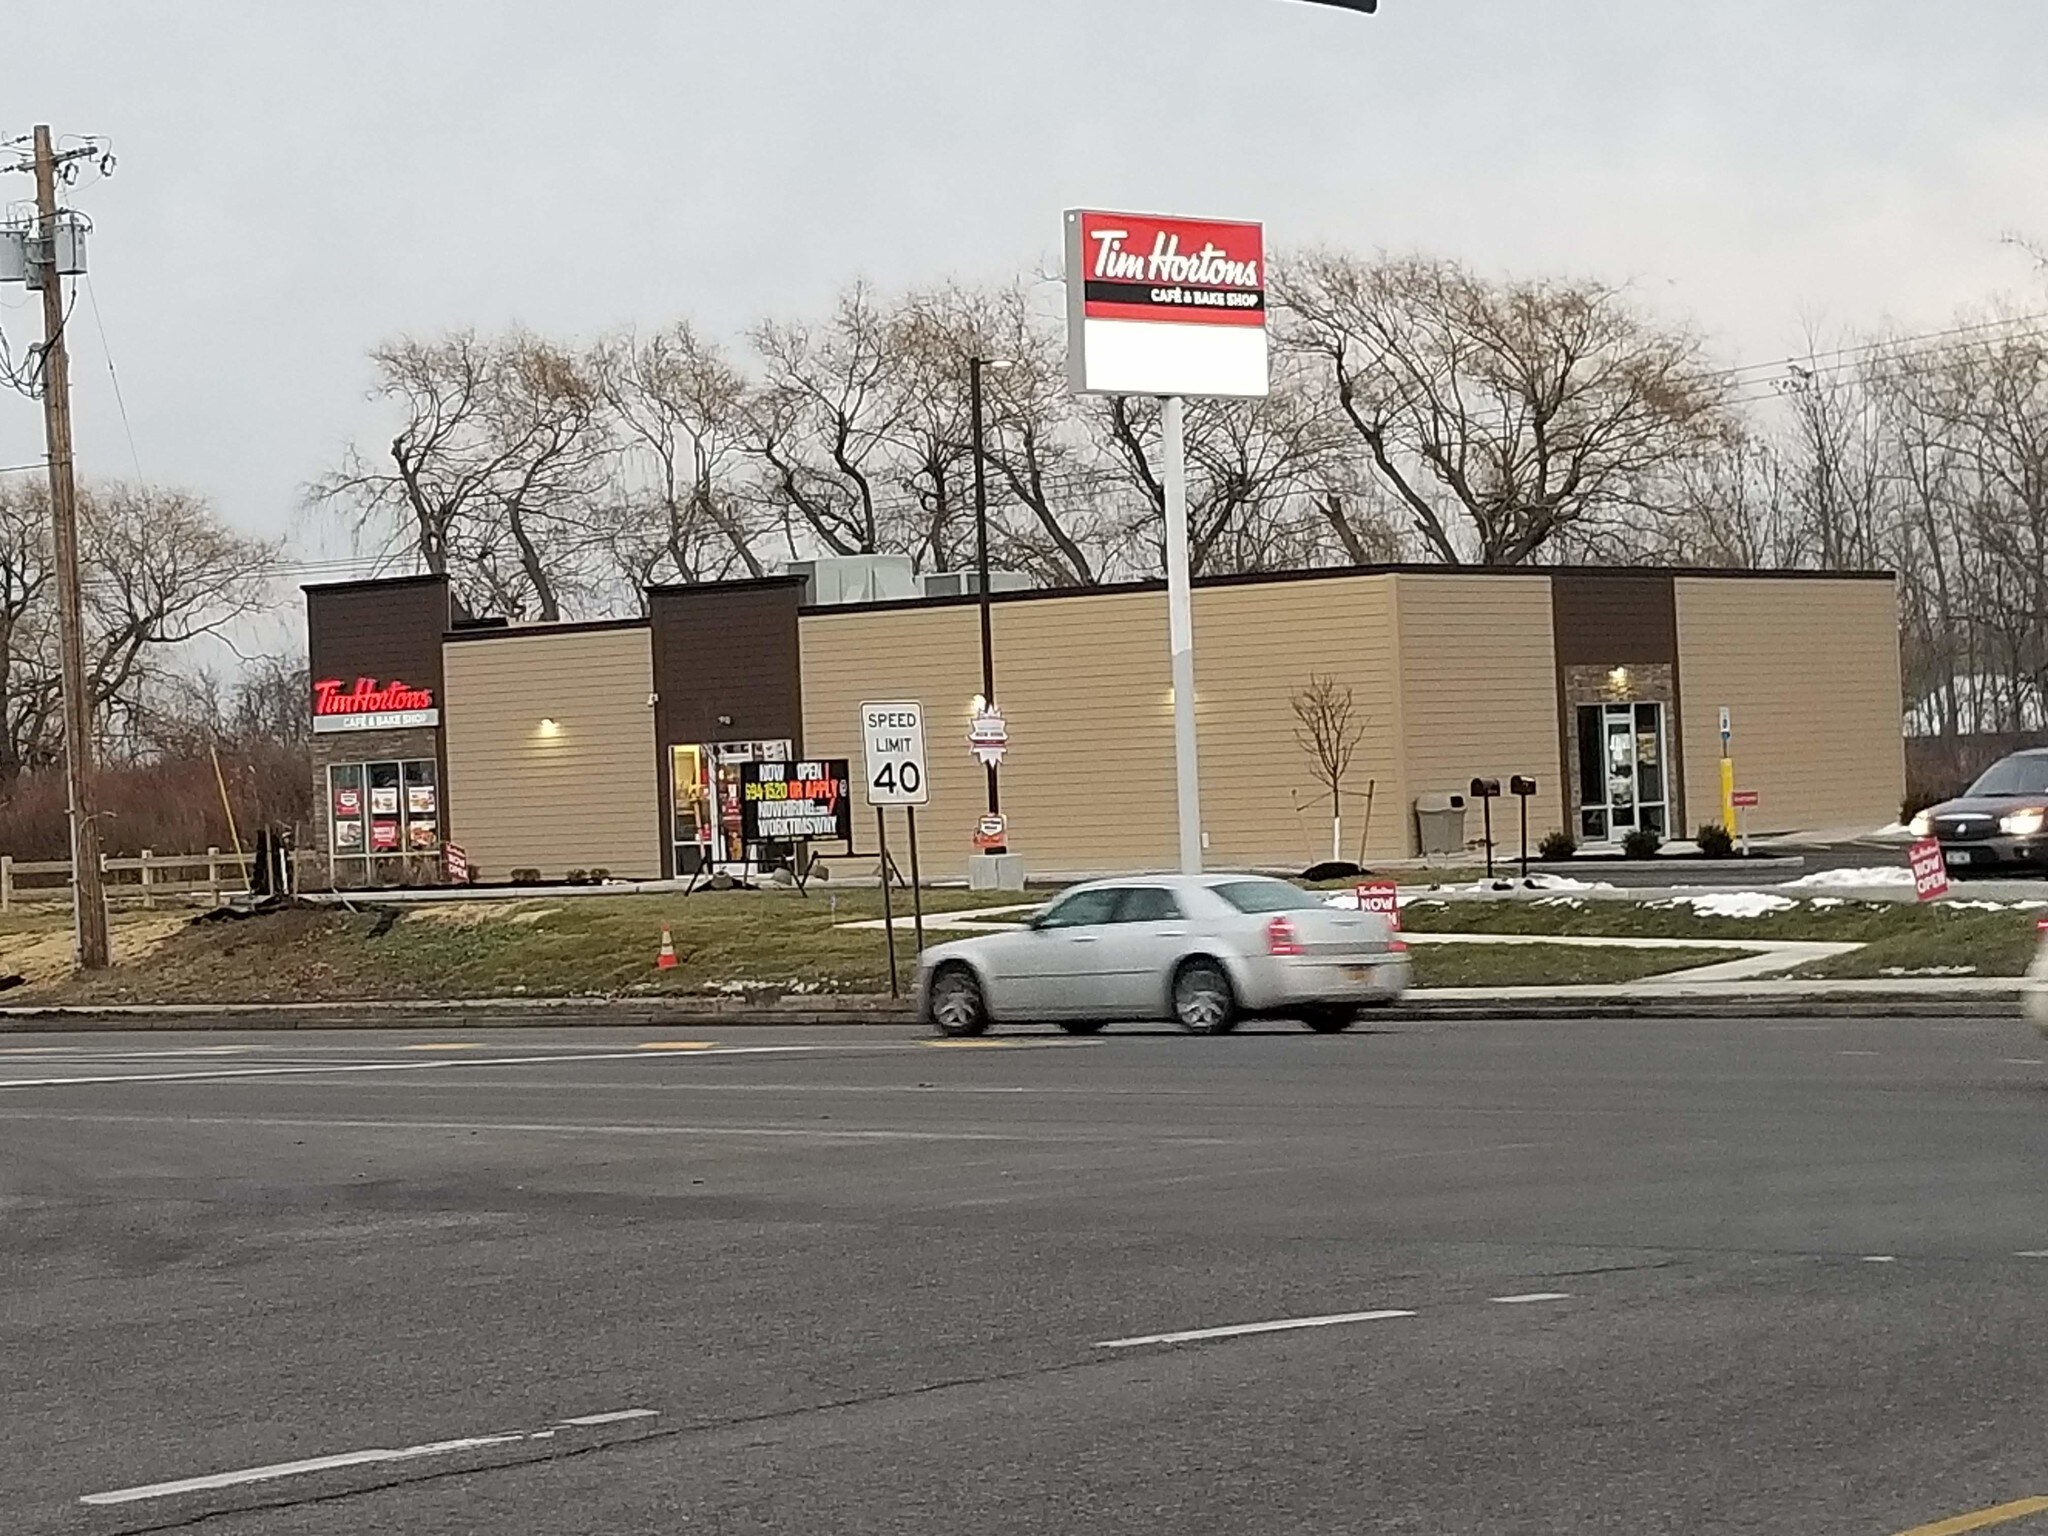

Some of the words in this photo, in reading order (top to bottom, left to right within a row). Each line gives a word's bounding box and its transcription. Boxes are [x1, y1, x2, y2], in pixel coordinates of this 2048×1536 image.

[1090, 229, 1145, 281] Tim
[1147, 230, 1259, 287] Hortons
[1183, 291, 1193, 303] &
[1193, 291, 1226, 306] BAKE
[1226, 293, 1259, 308] SHOP
[313, 679, 354, 715] Tim
[352, 676, 433, 712] Hortons
[368, 716, 376, 727] &
[376, 715, 401, 726] BAKE
[402, 713, 427, 725] SHOP
[868, 713, 917, 728] SPEED
[876, 738, 912, 753] LIMIT
[758, 763, 785, 782] NOW
[873, 761, 920, 794] 40
[789, 780, 803, 799] OR
[805, 779, 838, 799] APPLY
[1913, 855, 1940, 877] NOW
[1917, 871, 1947, 894] OPEN
[1361, 897, 1394, 911] NOW
